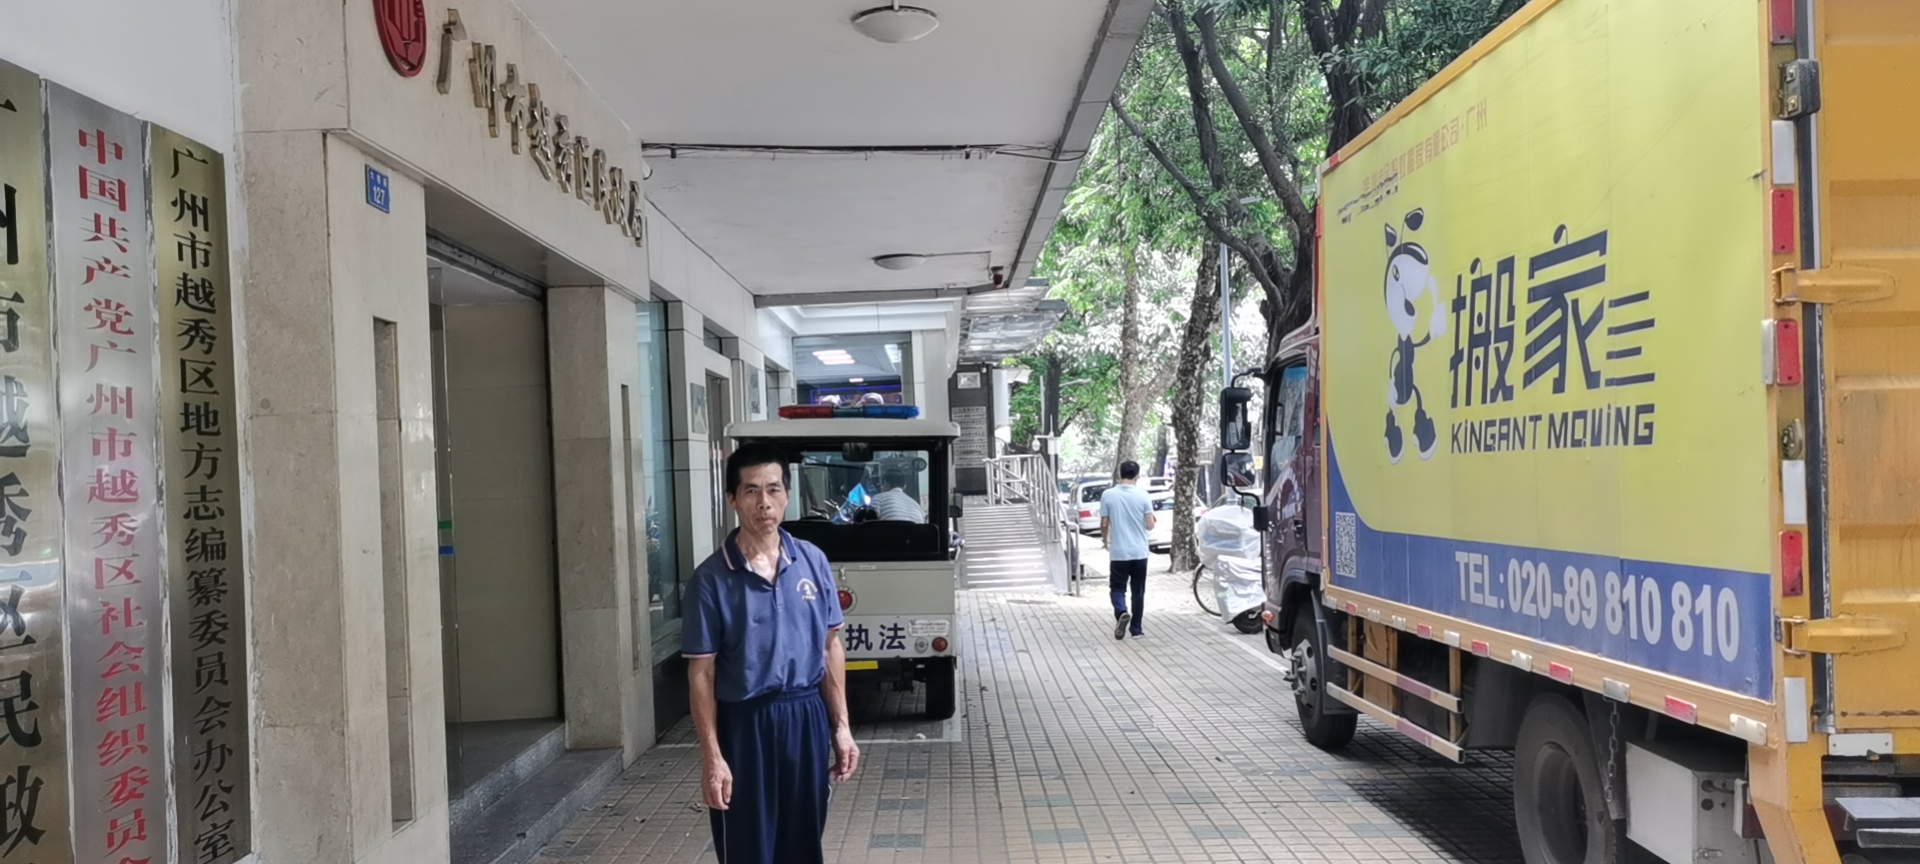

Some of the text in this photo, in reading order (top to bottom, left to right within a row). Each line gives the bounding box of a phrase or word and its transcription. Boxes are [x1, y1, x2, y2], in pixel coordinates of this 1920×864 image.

[373, 185, 385, 206] 127
[1450, 224, 1607, 408] 搬家
[78, 128, 151, 864] 中国共产党广州市越秀区社会组织委员
[170, 147, 235, 864] 广州市越秀区地方志编纂委员会办公室
[845, 623, 906, 651] 执法
[1604, 571, 1662, 645] 810
[1671, 580, 1740, 662] 810
